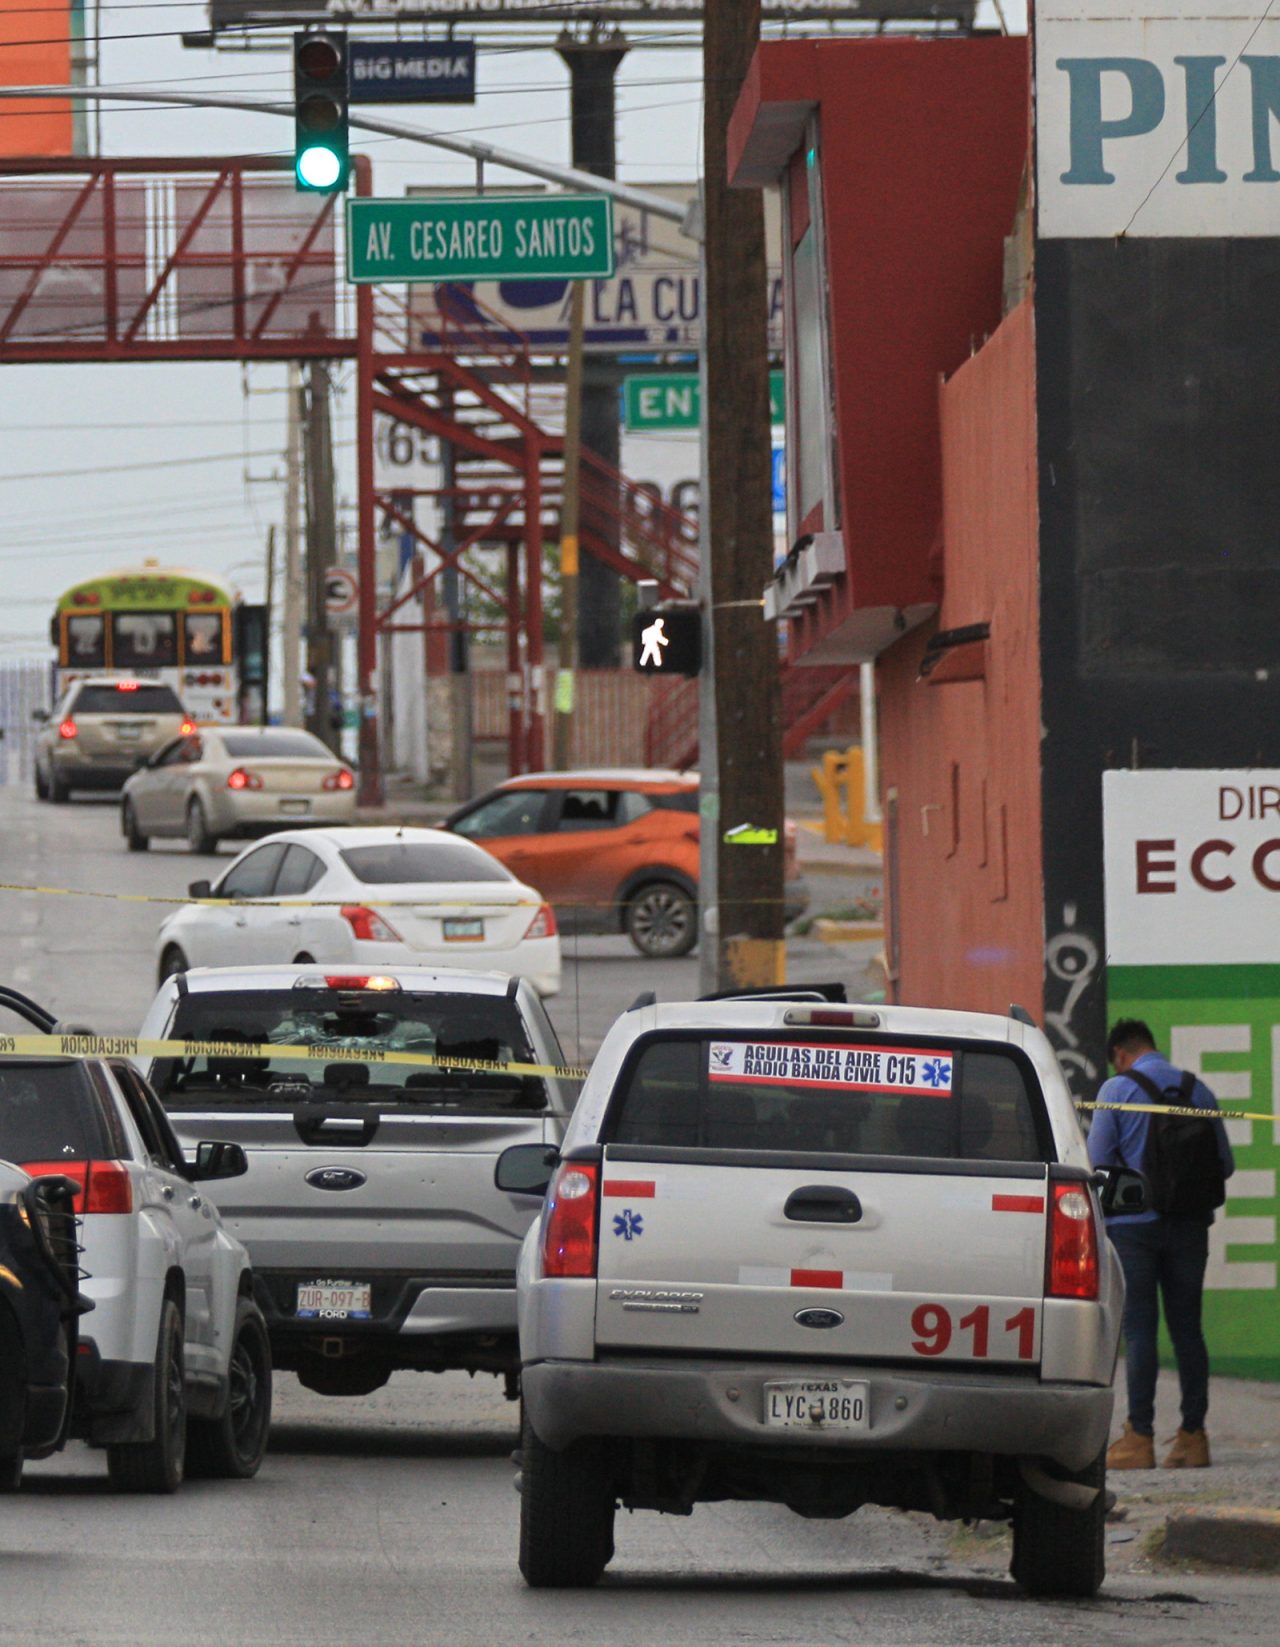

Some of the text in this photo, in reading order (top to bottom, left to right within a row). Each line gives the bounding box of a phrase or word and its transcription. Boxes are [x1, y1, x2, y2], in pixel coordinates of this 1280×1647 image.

[353, 55, 469, 80] BIG MEDIA
[366, 216, 595, 261] AV. CESAREO SANTOS
[593, 278, 638, 323] LA
[744, 1045, 811, 1063] AGUILAS
[815, 1050, 842, 1066] DEL
[845, 1052, 881, 1068] AIRE
[743, 1060, 881, 1083] RADIO BANDA CIVIL
[887, 1055, 917, 1085] C15
[319, 1309, 348, 1319] FORD
[911, 1303, 1036, 1360] 911
[800, 1382, 839, 1392] TEXAS
